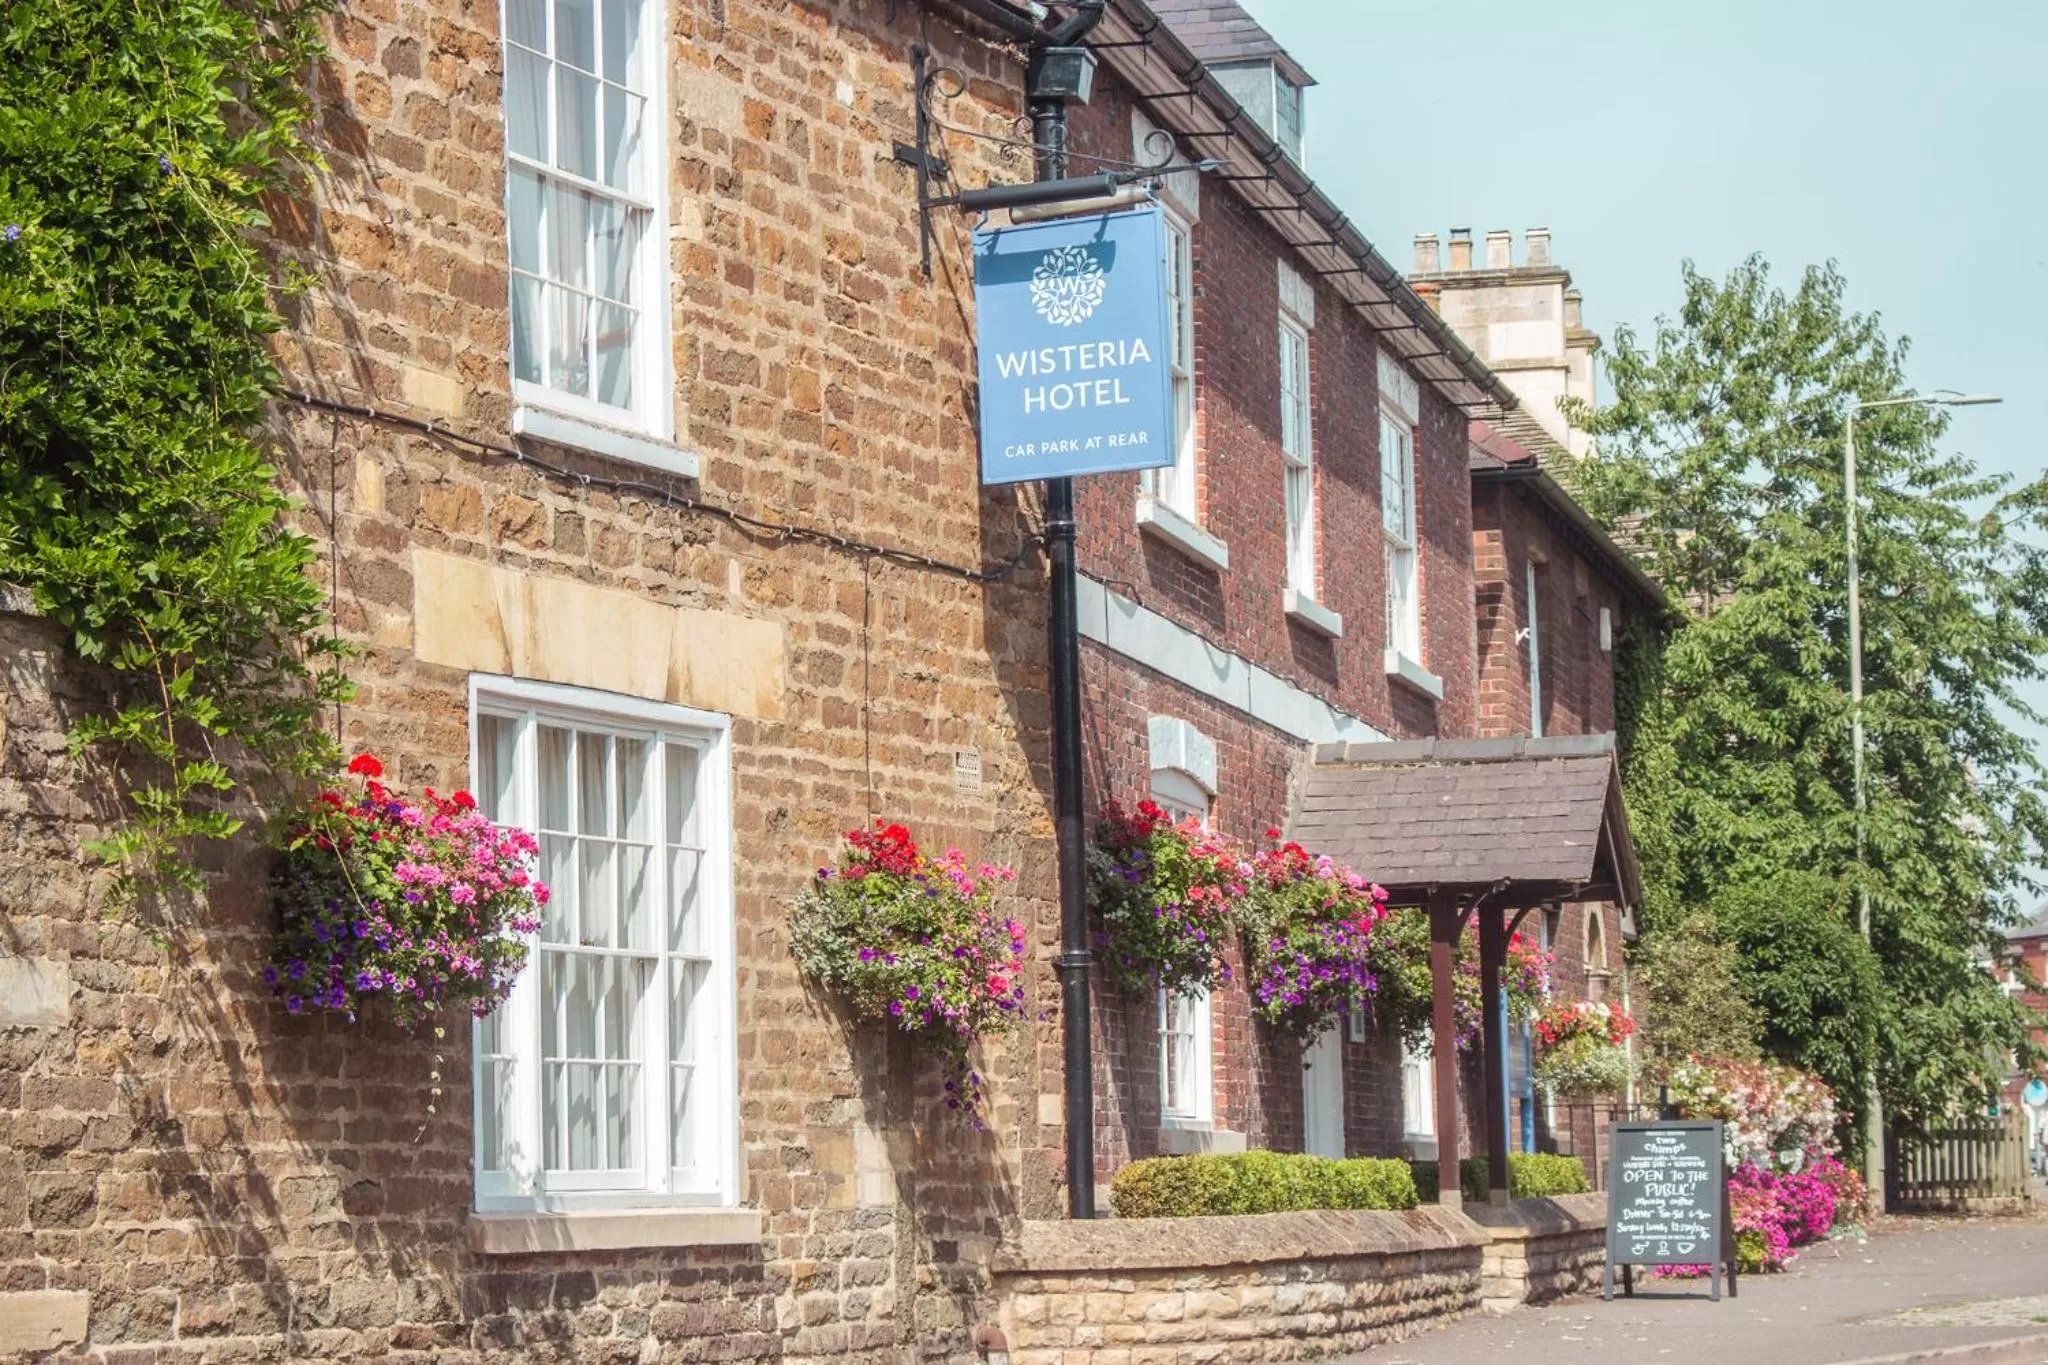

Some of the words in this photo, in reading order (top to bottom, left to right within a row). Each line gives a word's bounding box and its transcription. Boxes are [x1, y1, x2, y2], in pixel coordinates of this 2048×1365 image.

[996, 338, 1151, 379] WISTERIA
[1024, 378, 1130, 415] HOTEL
[1005, 443, 1035, 458] CAR
[1041, 439, 1079, 454] PARK
[1085, 436, 1102, 449] AT
[1109, 431, 1149, 447] REAR
[1624, 1170, 1664, 1182] OPEN
[1687, 1170, 1709, 1182] THE
[1644, 1182, 1696, 1197] PUBLIC!
